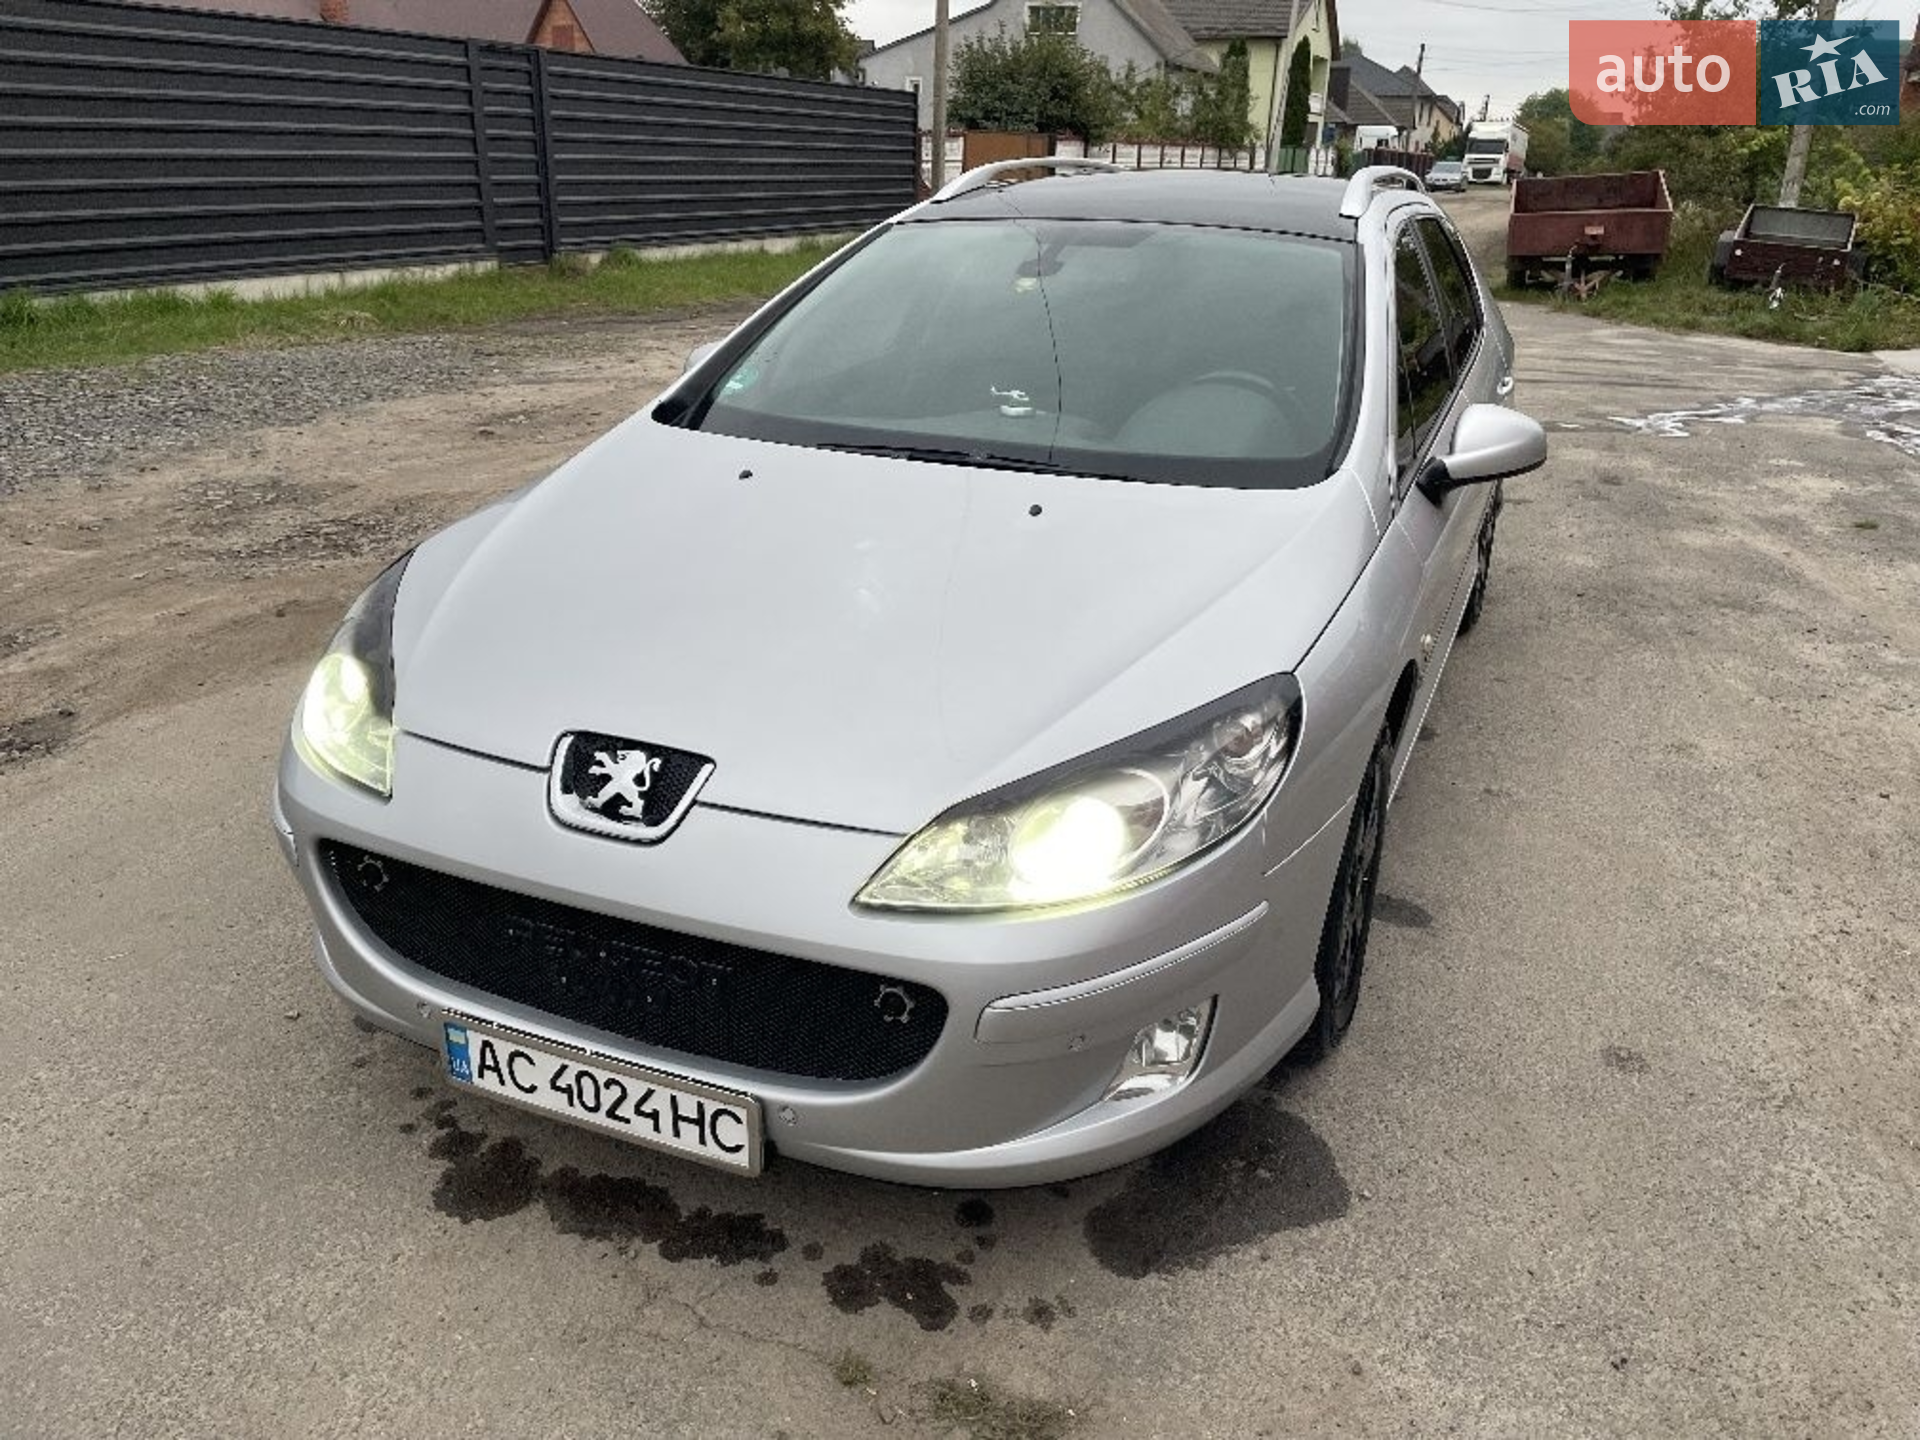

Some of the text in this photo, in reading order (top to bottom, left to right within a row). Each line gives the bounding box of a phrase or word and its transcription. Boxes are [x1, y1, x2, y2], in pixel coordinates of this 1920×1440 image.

[451, 1057, 470, 1076] UA
[477, 1039, 745, 1154] AC 4024 HC
